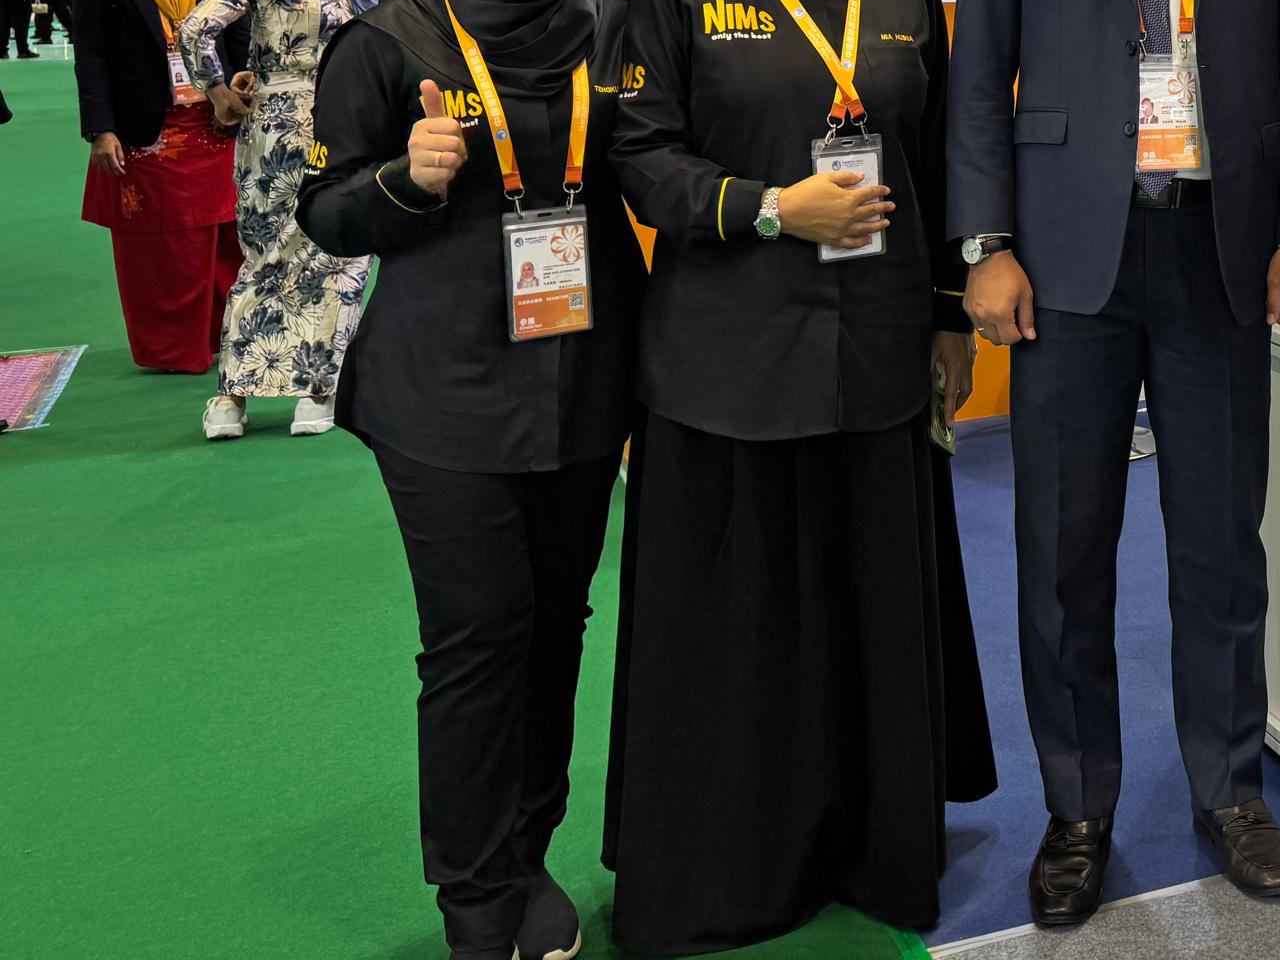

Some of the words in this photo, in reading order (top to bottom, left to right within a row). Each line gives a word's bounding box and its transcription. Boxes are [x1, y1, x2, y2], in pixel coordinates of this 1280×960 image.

[711, 32, 732, 41] only
[733, 31, 749, 39] the
[751, 31, 772, 40] best
[622, 63, 646, 89] MS
[307, 139, 328, 169] MS
